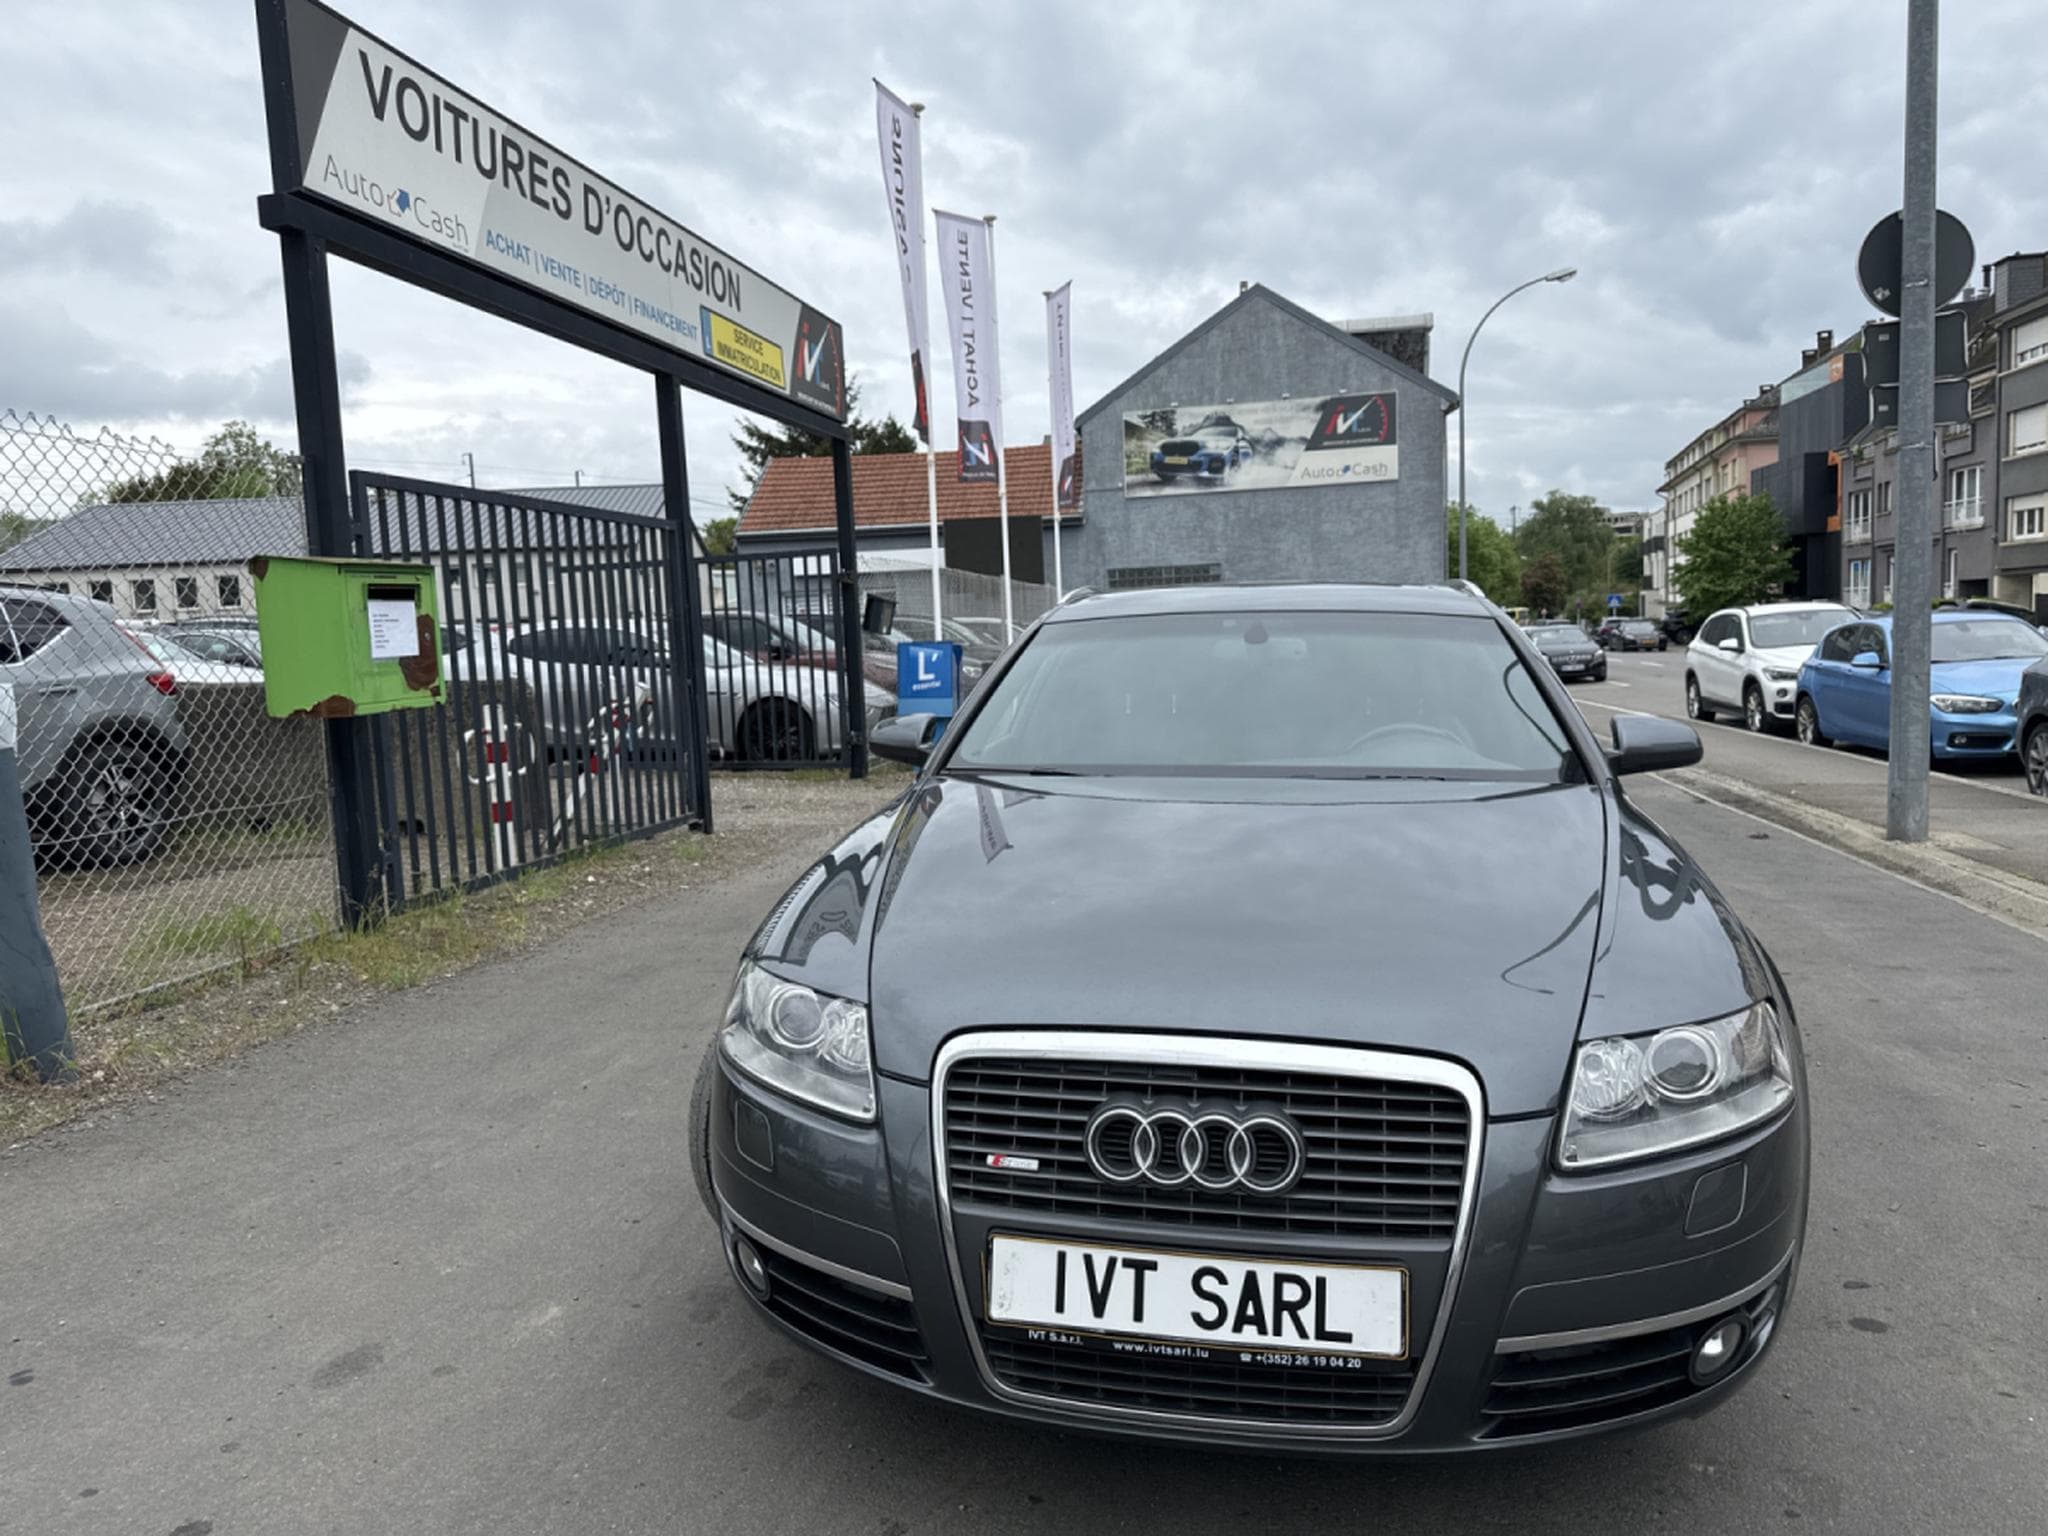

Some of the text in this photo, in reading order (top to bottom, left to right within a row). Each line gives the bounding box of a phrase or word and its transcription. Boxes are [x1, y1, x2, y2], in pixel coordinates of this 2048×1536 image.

[358, 49, 741, 312] VOITURES D'OCCASION
[324, 154, 469, 246] Auto Cash
[485, 229, 531, 265] ACHAT
[541, 258, 581, 289] VENTE
[589, 275, 626, 308] DÉPÔT
[633, 298, 699, 341] FINANCEMENT
[733, 328, 764, 356] SERVICE
[716, 341, 782, 382] IMMATRICULATION
[1300, 462, 1389, 480] Auto Cash
[1054, 1250, 1354, 1344] IVT SARL
[1028, 1329, 1046, 1340] IVT
[1113, 1341, 1210, 1358] www.ivtsarl.lu
[1256, 1354, 1362, 1369] +(352) 26 19 04 20
